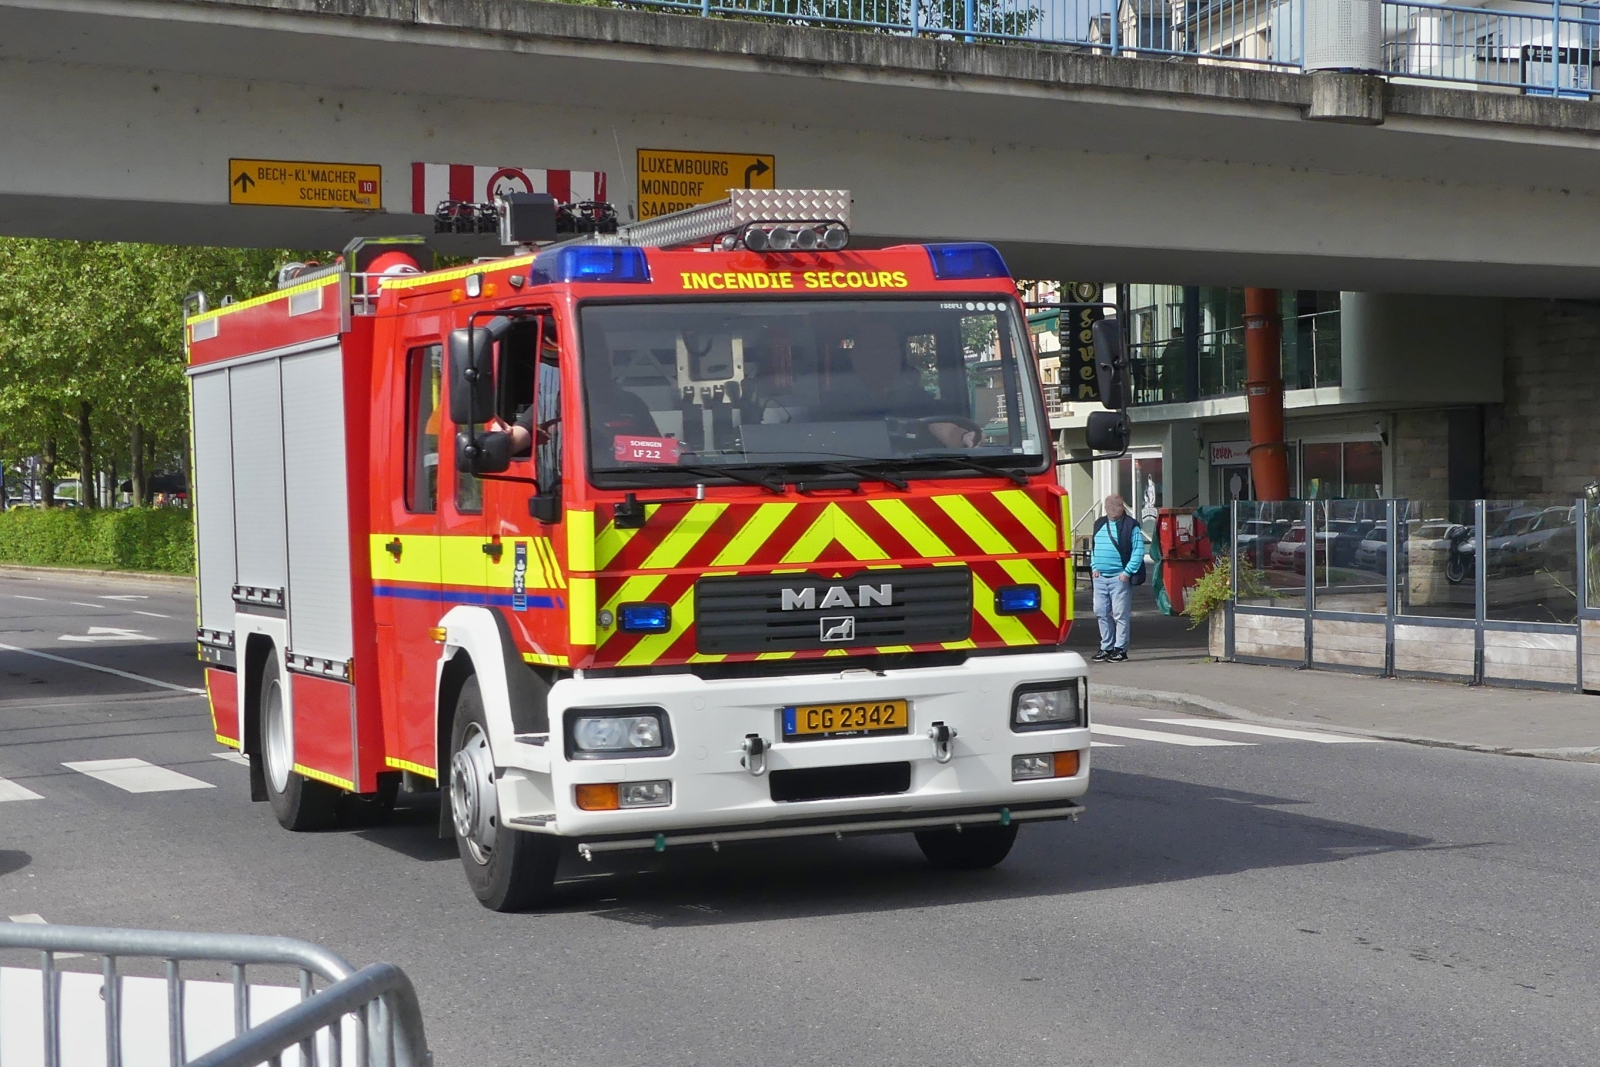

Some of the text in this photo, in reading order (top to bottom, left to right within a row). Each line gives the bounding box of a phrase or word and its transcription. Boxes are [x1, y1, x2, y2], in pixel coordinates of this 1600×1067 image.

[257, 167, 356, 183] BECH-KL'MACHER
[641, 157, 728, 176] LUXEMBOURG
[299, 187, 356, 201] SCHENGEN
[363, 182, 372, 192] 10
[641, 179, 704, 197] MONDORF
[680, 271, 908, 289] INCENDIE SECOURS
[633, 449, 661, 458] LF 2.2
[781, 584, 892, 610] MAN
[787, 705, 895, 730] L CG 2342
